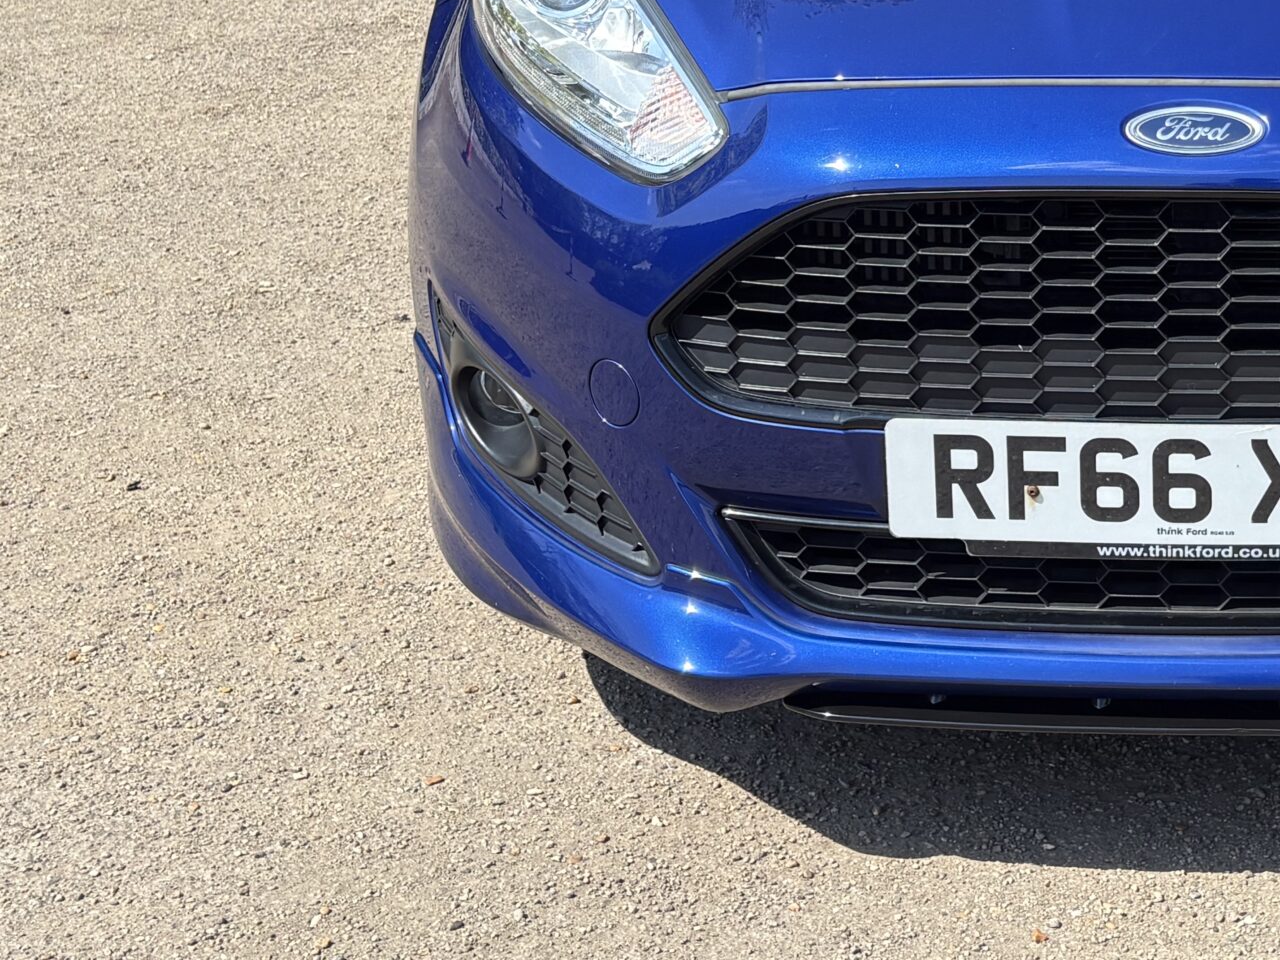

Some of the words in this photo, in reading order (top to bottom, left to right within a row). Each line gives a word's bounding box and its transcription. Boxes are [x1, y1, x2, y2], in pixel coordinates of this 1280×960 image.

[1156, 115, 1231, 142] Ford
[933, 434, 1213, 523] RF66
[1157, 527, 1183, 535] think
[1186, 527, 1207, 535] Ford
